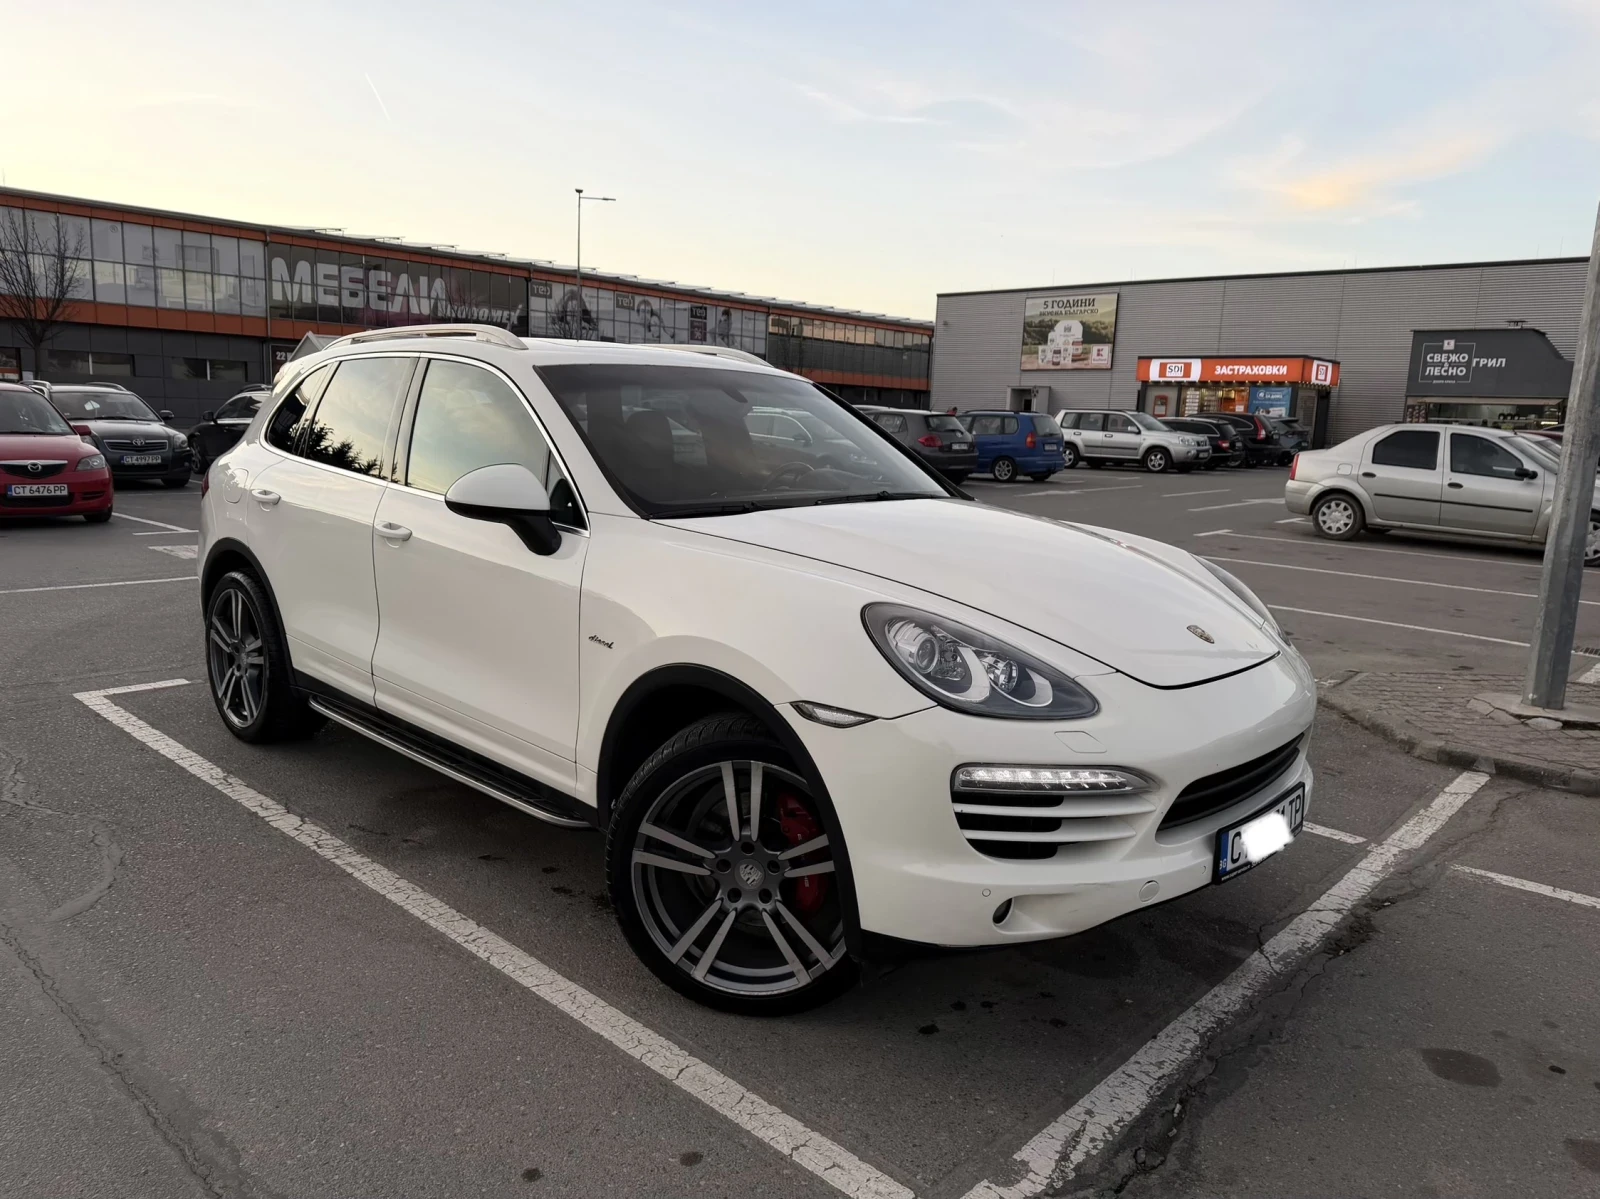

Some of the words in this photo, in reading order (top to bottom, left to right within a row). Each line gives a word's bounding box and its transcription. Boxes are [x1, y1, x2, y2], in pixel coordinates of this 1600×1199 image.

[271, 257, 447, 317] МЕБЕЛИ
[1043, 301, 1049, 310] 5
[1051, 298, 1096, 310] ГОДИНИ
[1426, 353, 1468, 362] СВЕЖО
[1472, 358, 1506, 367] ГРИЛ
[1167, 365, 1183, 374] SDI
[1214, 364, 1288, 376] ЗАСТРАХОВКИ
[1425, 367, 1466, 376] ЛЕСНО
[13, 487, 27, 495] CT
[29, 486, 53, 495] 6476
[54, 486, 66, 494] PP
